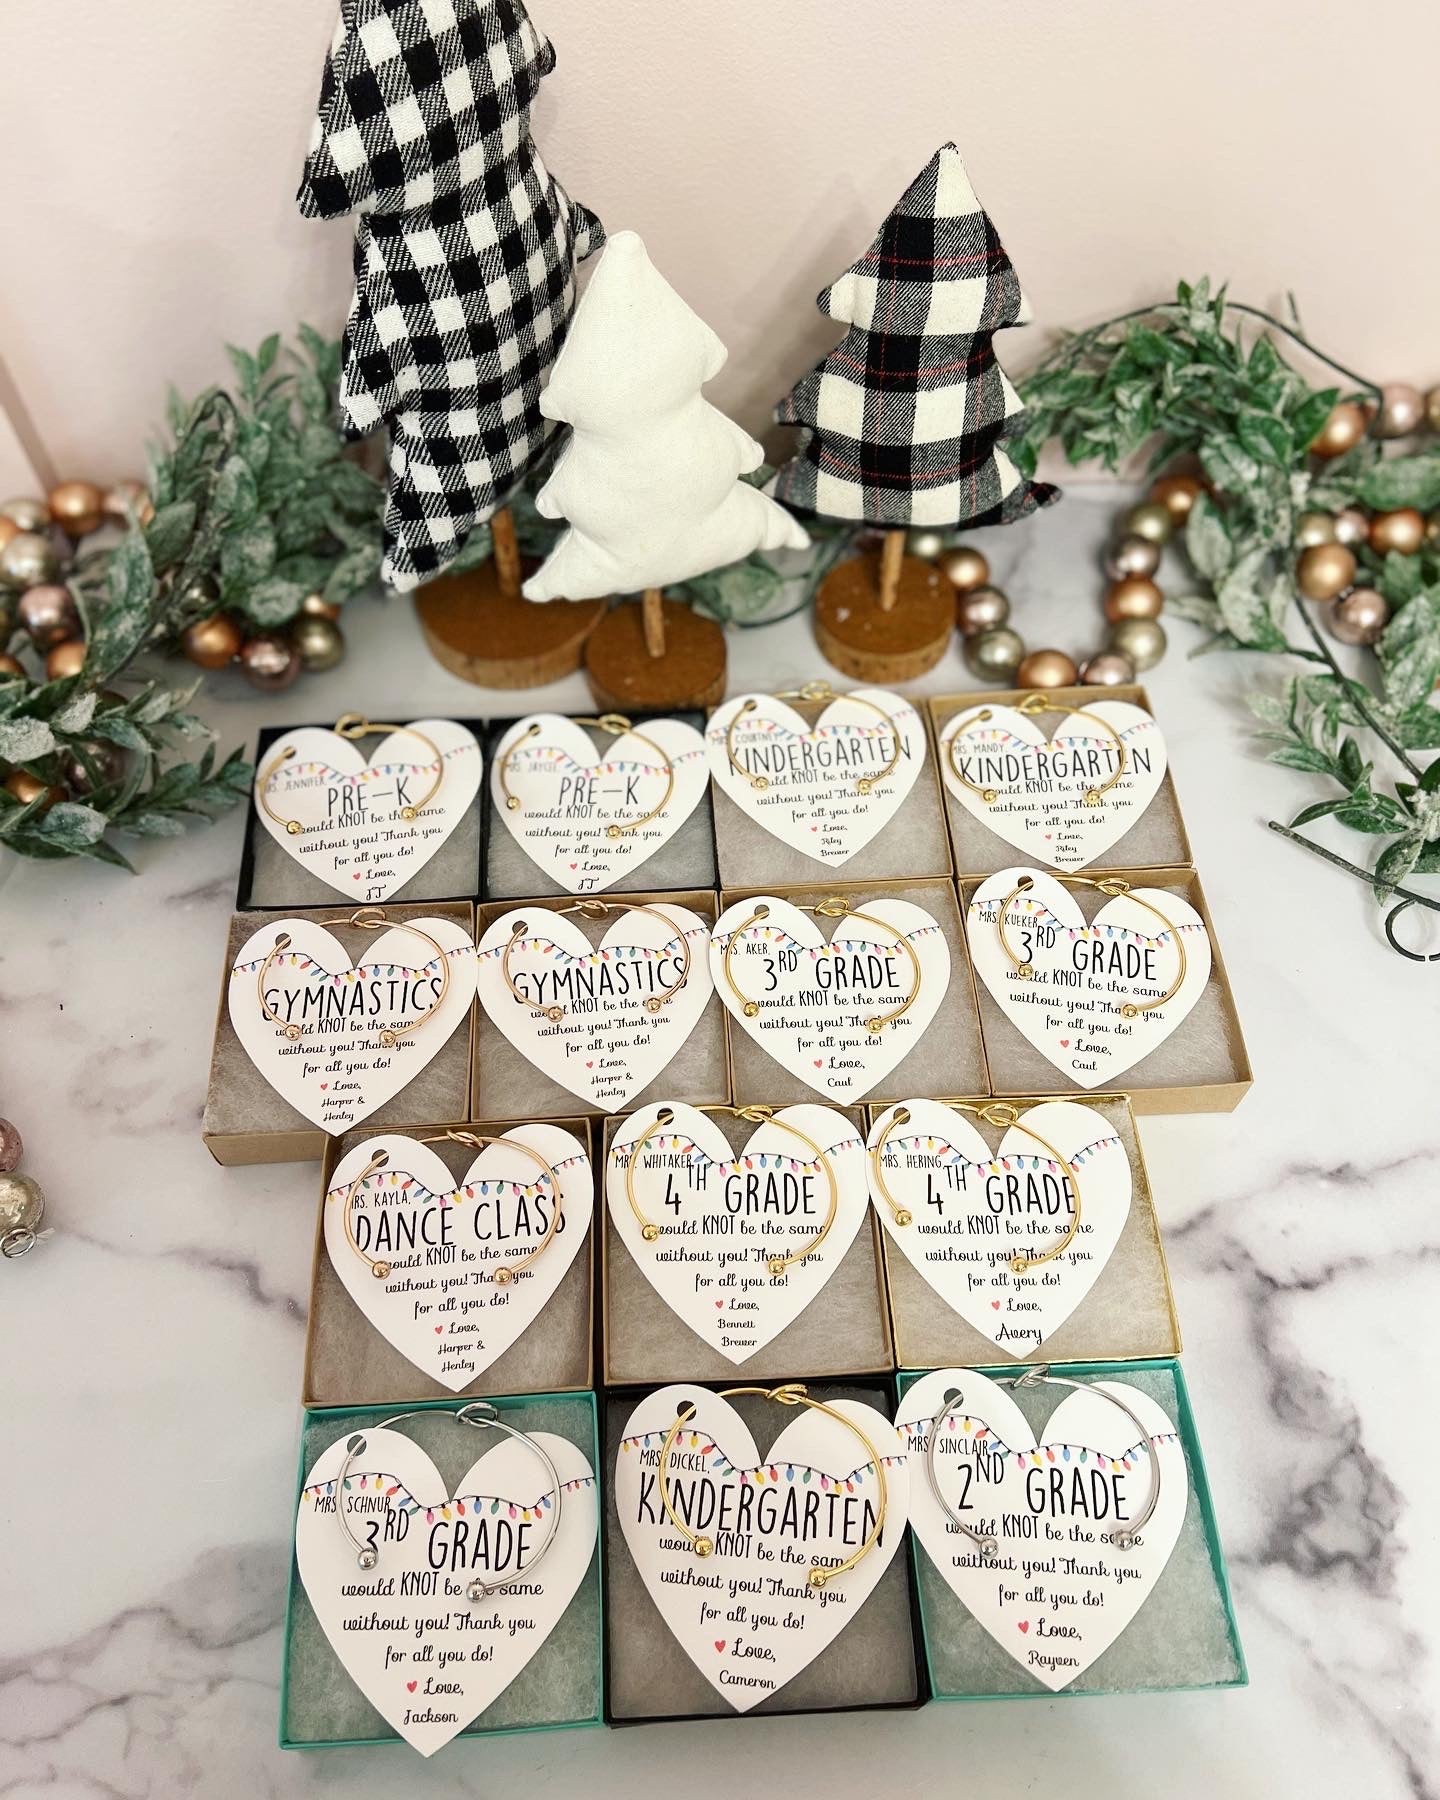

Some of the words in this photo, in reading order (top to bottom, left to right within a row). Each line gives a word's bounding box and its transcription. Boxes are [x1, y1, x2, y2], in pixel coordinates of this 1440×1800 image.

[792, 769, 818, 784] KNOT
[1026, 780, 1053, 793] KNOT
[757, 795, 804, 806] without
[808, 790, 833, 805] you!
[338, 811, 367, 828] KNOT
[566, 805, 594, 818] KNOT
[822, 824, 847, 832] Love,
[1025, 820, 1041, 830] for
[1046, 817, 1060, 826] all
[1064, 818, 1085, 828] you
[1089, 816, 1105, 825] do!
[299, 839, 348, 854] without
[353, 834, 379, 849] you!
[380, 826, 420, 842] Thank
[422, 828, 443, 840] you
[555, 846, 570, 857] for
[575, 846, 589, 854] all
[593, 847, 612, 857] you
[616, 846, 632, 854] do!
[366, 869, 396, 880] Love,
[582, 862, 610, 871] Love,
[1020, 925, 1056, 964] 3RD
[1072, 939, 1157, 980] GRADE
[763, 949, 798, 991] 3RD
[815, 955, 900, 990] GRADE
[1053, 969, 1083, 988] KNOT
[513, 957, 687, 1004] GYMNASTICS
[261, 977, 442, 1022] GYMNASTICS
[572, 997, 599, 1014] KNOT
[799, 990, 829, 1006] KNOT
[1009, 993, 1063, 1007] without
[1067, 1000, 1095, 1013] you!
[318, 1017, 346, 1033] KNOT
[537, 1024, 584, 1037] without
[587, 1020, 611, 1035] you!
[613, 1017, 649, 1029] Thank
[651, 1017, 671, 1030] you
[798, 1038, 815, 1052] for
[819, 1037, 836, 1047] all
[839, 1038, 861, 1050] you
[865, 1035, 882, 1045] do!
[1075, 1039, 1112, 1055] Love,
[303, 1064, 320, 1078] for
[325, 1061, 342, 1072] all
[346, 1062, 369, 1075] you
[373, 1058, 391, 1069] do!
[599, 1059, 626, 1068] Love,
[828, 1057, 865, 1069] Love,
[332, 1081, 362, 1090] Love,
[591, 1075, 622, 1085] Harper
[596, 1088, 626, 1098] Henley
[322, 1098, 354, 1108] Harper
[323, 1112, 354, 1122] Henley
[664, 1164, 707, 1216] 4TH
[725, 1172, 816, 1215] GRADE
[927, 1165, 967, 1215] 4TH
[986, 1173, 1076, 1216] GRADE
[355, 1207, 454, 1252] DANCE
[474, 1193, 566, 1240] CLASS
[702, 1215, 735, 1235] KNOT
[967, 1215, 1000, 1235] KNOT
[426, 1245, 456, 1266] KNOT
[385, 1279, 437, 1293] without
[441, 1274, 468, 1292] you!
[695, 1274, 714, 1292] for
[719, 1274, 737, 1287] all
[740, 1277, 765, 1292] you
[769, 1275, 788, 1287] do!
[967, 1273, 986, 1291] for
[991, 1273, 1010, 1286] all
[1013, 1276, 1038, 1291] you
[1041, 1274, 1061, 1287] do!
[729, 1299, 759, 1310] Love,
[1006, 1298, 1042, 1312] Love,
[449, 1323, 480, 1333] Love,
[717, 1318, 755, 1329] Bennett
[995, 1323, 1043, 1345] Avery
[437, 1342, 473, 1355] Harper
[477, 1340, 485, 1350] &
[441, 1360, 475, 1372] Henley
[957, 1451, 1005, 1511] 2ND
[1026, 1466, 1130, 1521] GRADE
[637, 1472, 884, 1548] KINDERGARTEN
[1002, 1514, 1039, 1539] KNOT
[428, 1519, 533, 1572] GRADE
[715, 1531, 752, 1559] KNOT
[952, 1553, 1017, 1571] without
[1022, 1556, 1057, 1580] you!
[1059, 1556, 1110, 1577] Thank
[1114, 1565, 1142, 1585] you
[400, 1571, 440, 1596] KNOT
[660, 1569, 723, 1590] without
[729, 1578, 764, 1598] you!
[766, 1577, 815, 1599] Thank
[819, 1589, 847, 1607] you
[999, 1583, 1019, 1606] for
[1026, 1587, 1046, 1603] all
[1050, 1591, 1078, 1609] you
[1083, 1590, 1105, 1607] do!
[342, 1615, 410, 1632] without
[415, 1613, 450, 1638] you!
[453, 1612, 504, 1631] Thank
[508, 1617, 536, 1635] you
[700, 1602, 721, 1625] for
[726, 1607, 748, 1623] all
[751, 1612, 778, 1631] you
[783, 1612, 805, 1630] do!
[1037, 1617, 1082, 1640] Love,
[385, 1646, 407, 1669] for
[412, 1646, 434, 1662] all
[438, 1650, 466, 1668] you
[471, 1646, 493, 1662] do!
[731, 1637, 777, 1663] Love,
[1028, 1649, 1080, 1671] Rayven
[423, 1681, 464, 1696] Love,
[719, 1669, 777, 1690] Cameron
[403, 1709, 459, 1725] Jackson
